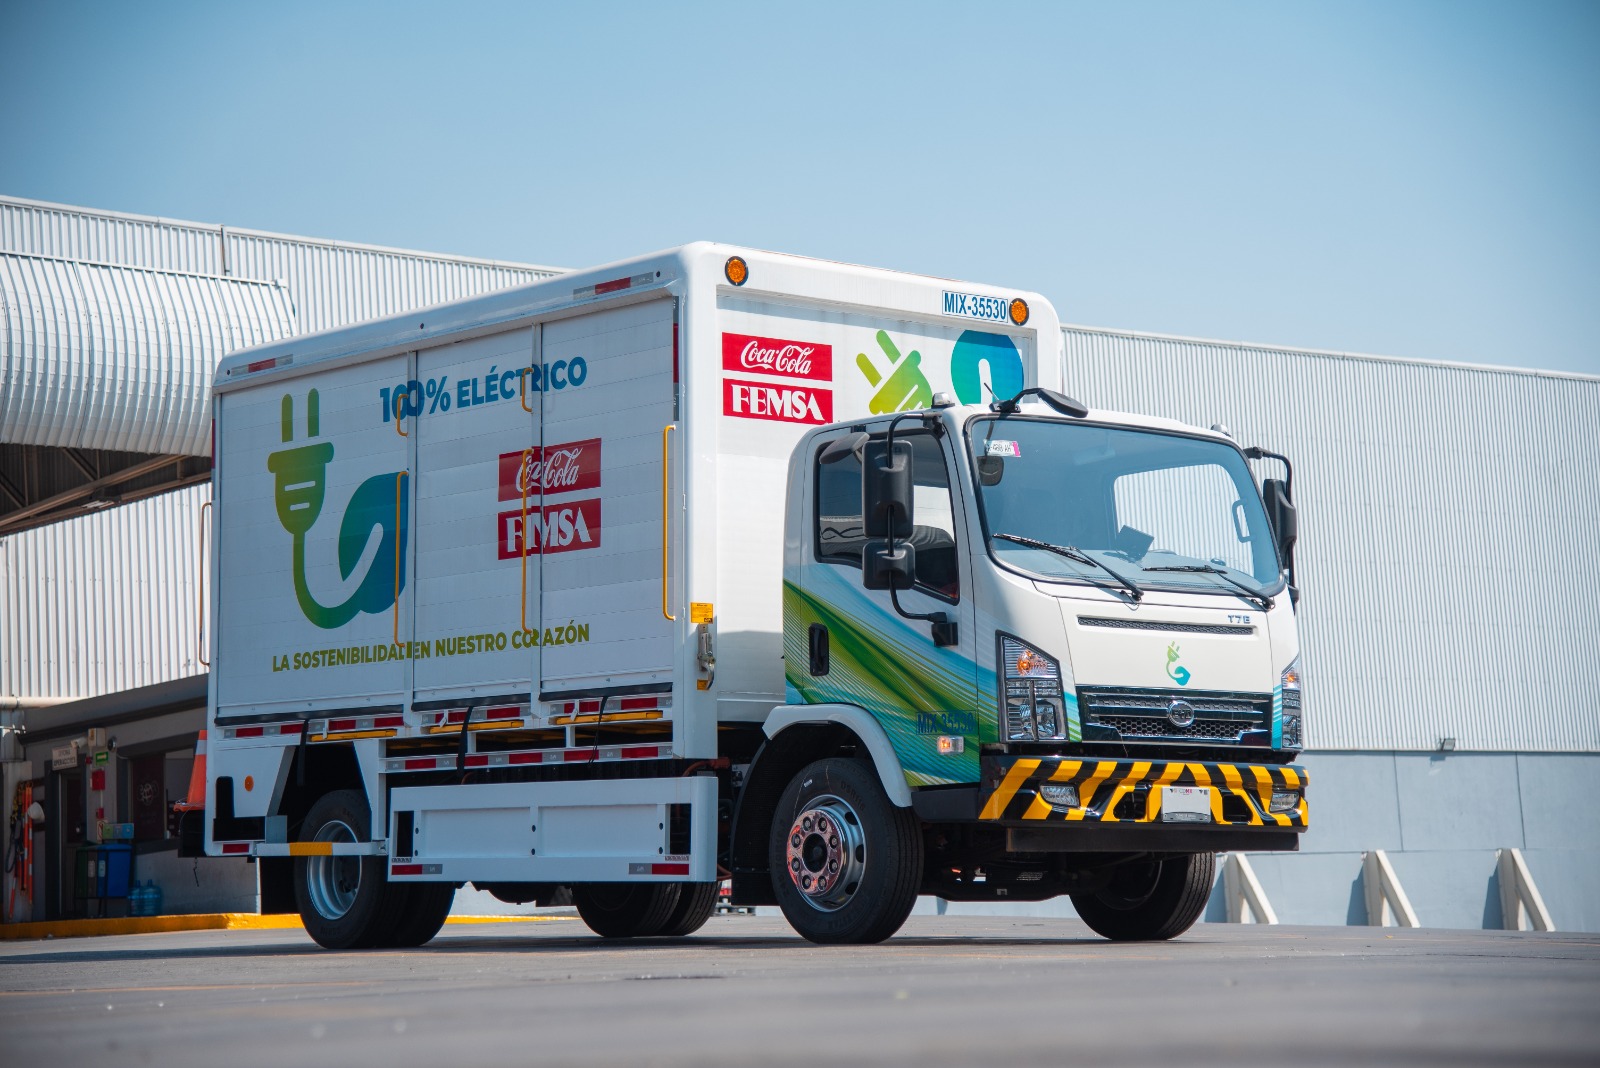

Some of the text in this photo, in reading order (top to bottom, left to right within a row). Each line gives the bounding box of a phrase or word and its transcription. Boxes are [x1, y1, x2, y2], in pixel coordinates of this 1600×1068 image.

[944, 291, 1006, 320] MIX-35530
[740, 340, 815, 375] Coca-Cola
[380, 357, 587, 422] 100% ELÉCTRICO
[731, 384, 826, 421] FEMSA
[272, 654, 290, 672] LA
[406, 641, 430, 660] EN
[436, 631, 507, 657] NUESTRO
[511, 619, 590, 649] CORAZÓN
